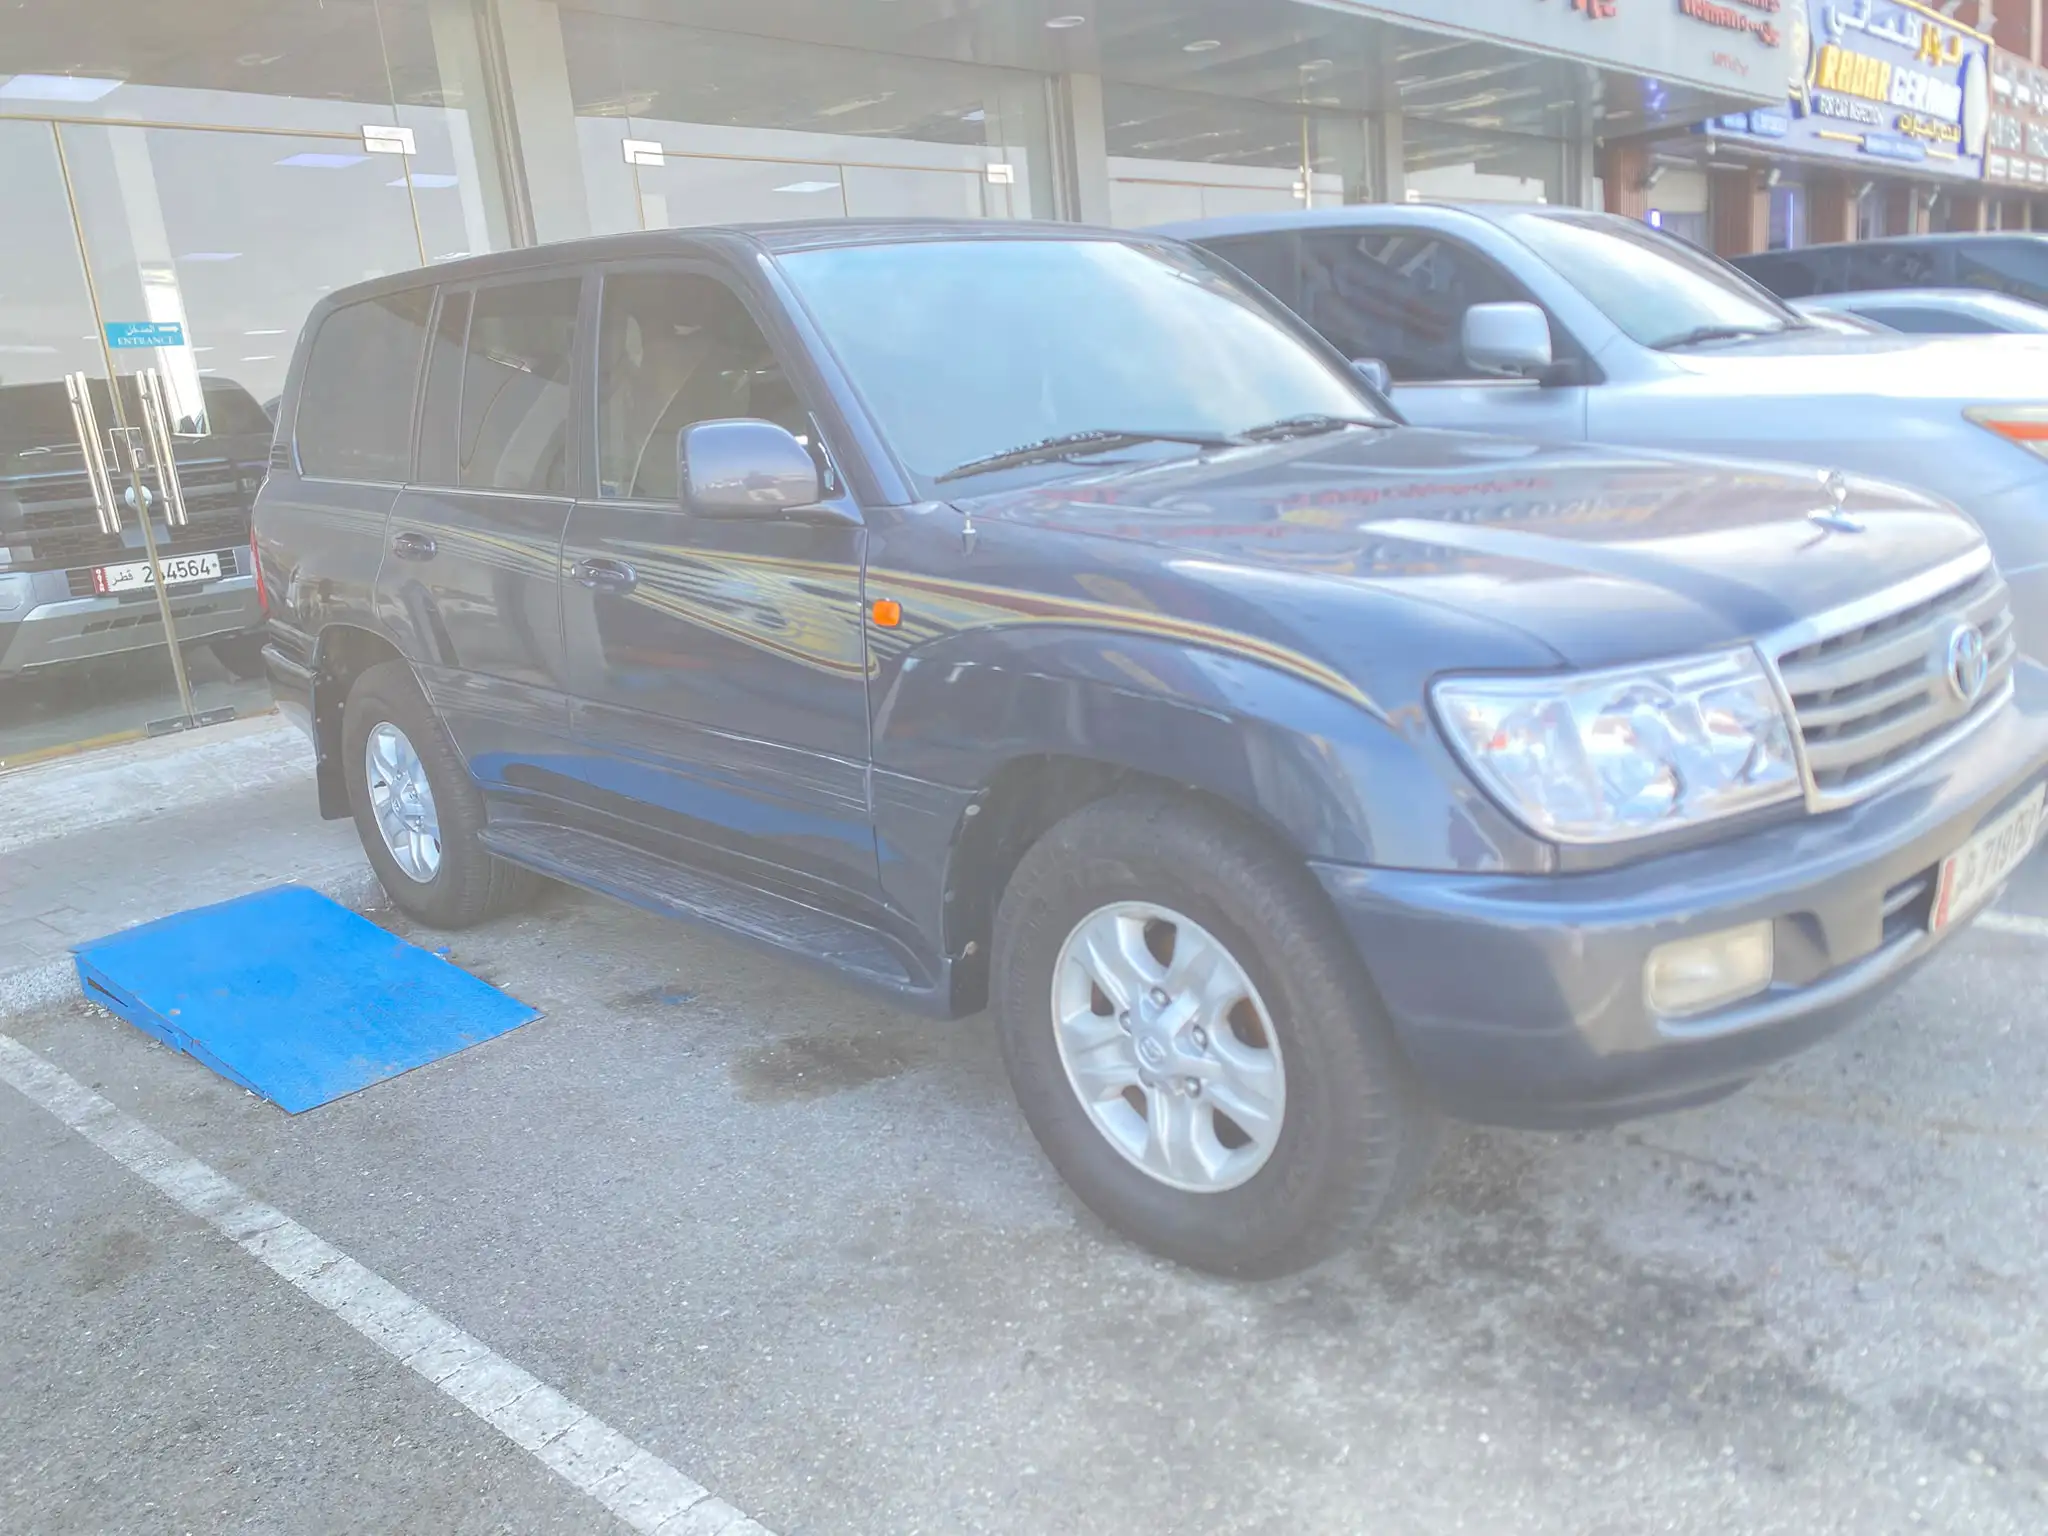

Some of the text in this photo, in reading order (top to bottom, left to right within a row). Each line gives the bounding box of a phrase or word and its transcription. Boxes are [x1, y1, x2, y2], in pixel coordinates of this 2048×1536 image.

[1819, 44, 1891, 101] RADAR
[117, 335, 174, 346] ENTRANCE
[111, 569, 134, 586] قطر
[142, 558, 211, 584] 24564
